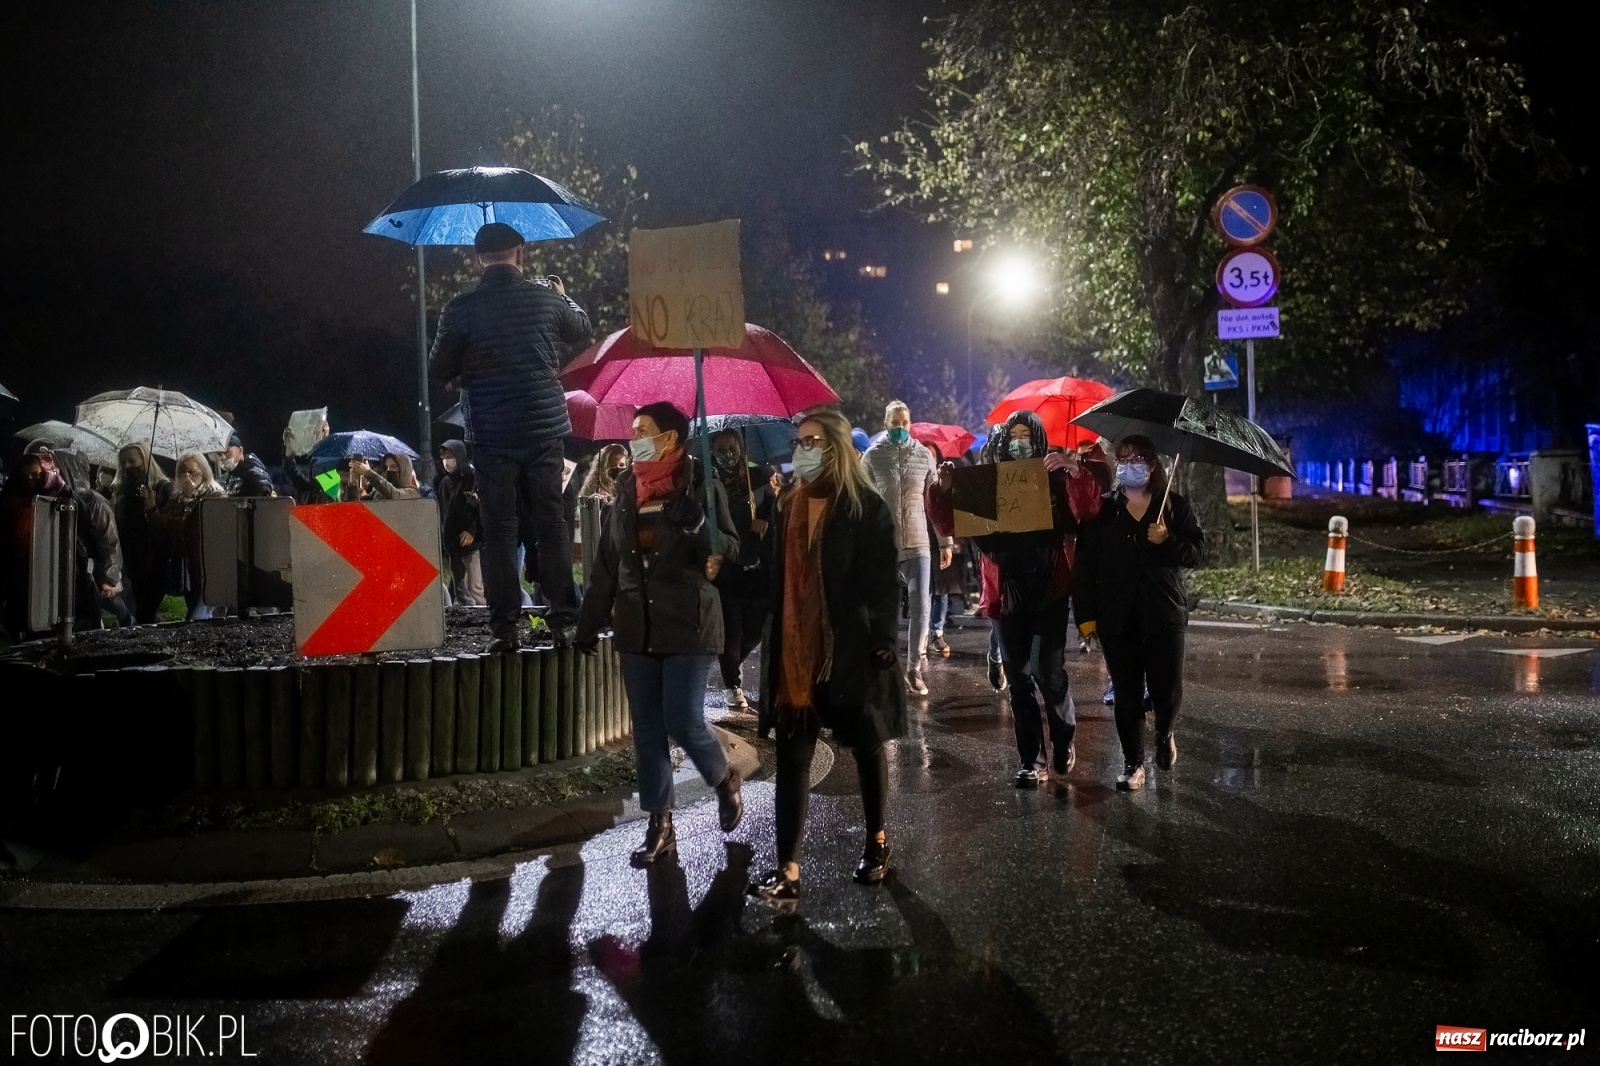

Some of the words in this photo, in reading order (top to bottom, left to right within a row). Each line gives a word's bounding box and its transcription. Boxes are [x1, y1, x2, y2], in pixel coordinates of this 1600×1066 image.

[1229, 267, 1270, 291] 3,5t
[632, 294, 669, 342] NO
[1227, 325, 1244, 333] PKS
[1251, 324, 1270, 332] PKM
